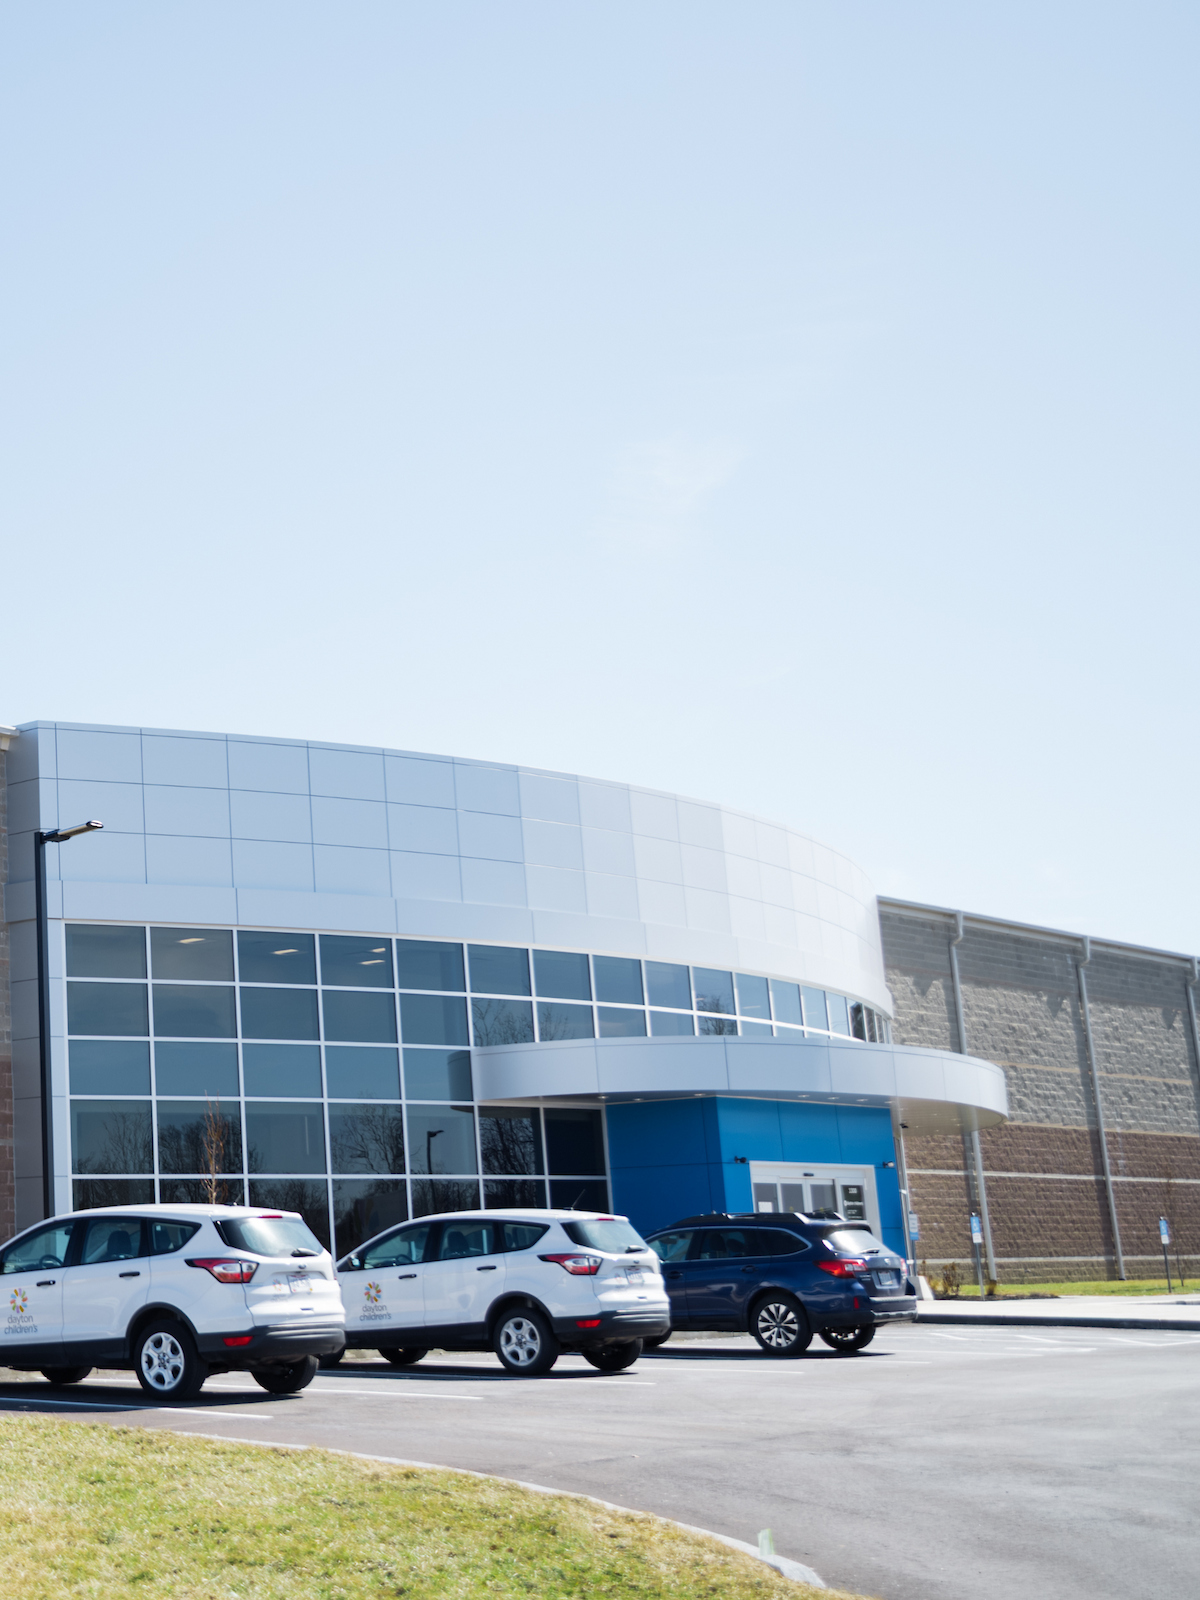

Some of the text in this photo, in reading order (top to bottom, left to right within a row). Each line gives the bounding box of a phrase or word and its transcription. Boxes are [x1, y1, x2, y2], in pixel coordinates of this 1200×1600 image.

[362, 1304, 387, 1313] dayton
[7, 1315, 33, 1325] dayton
[359, 1312, 391, 1321] children's
[4, 1324, 38, 1335] children's
